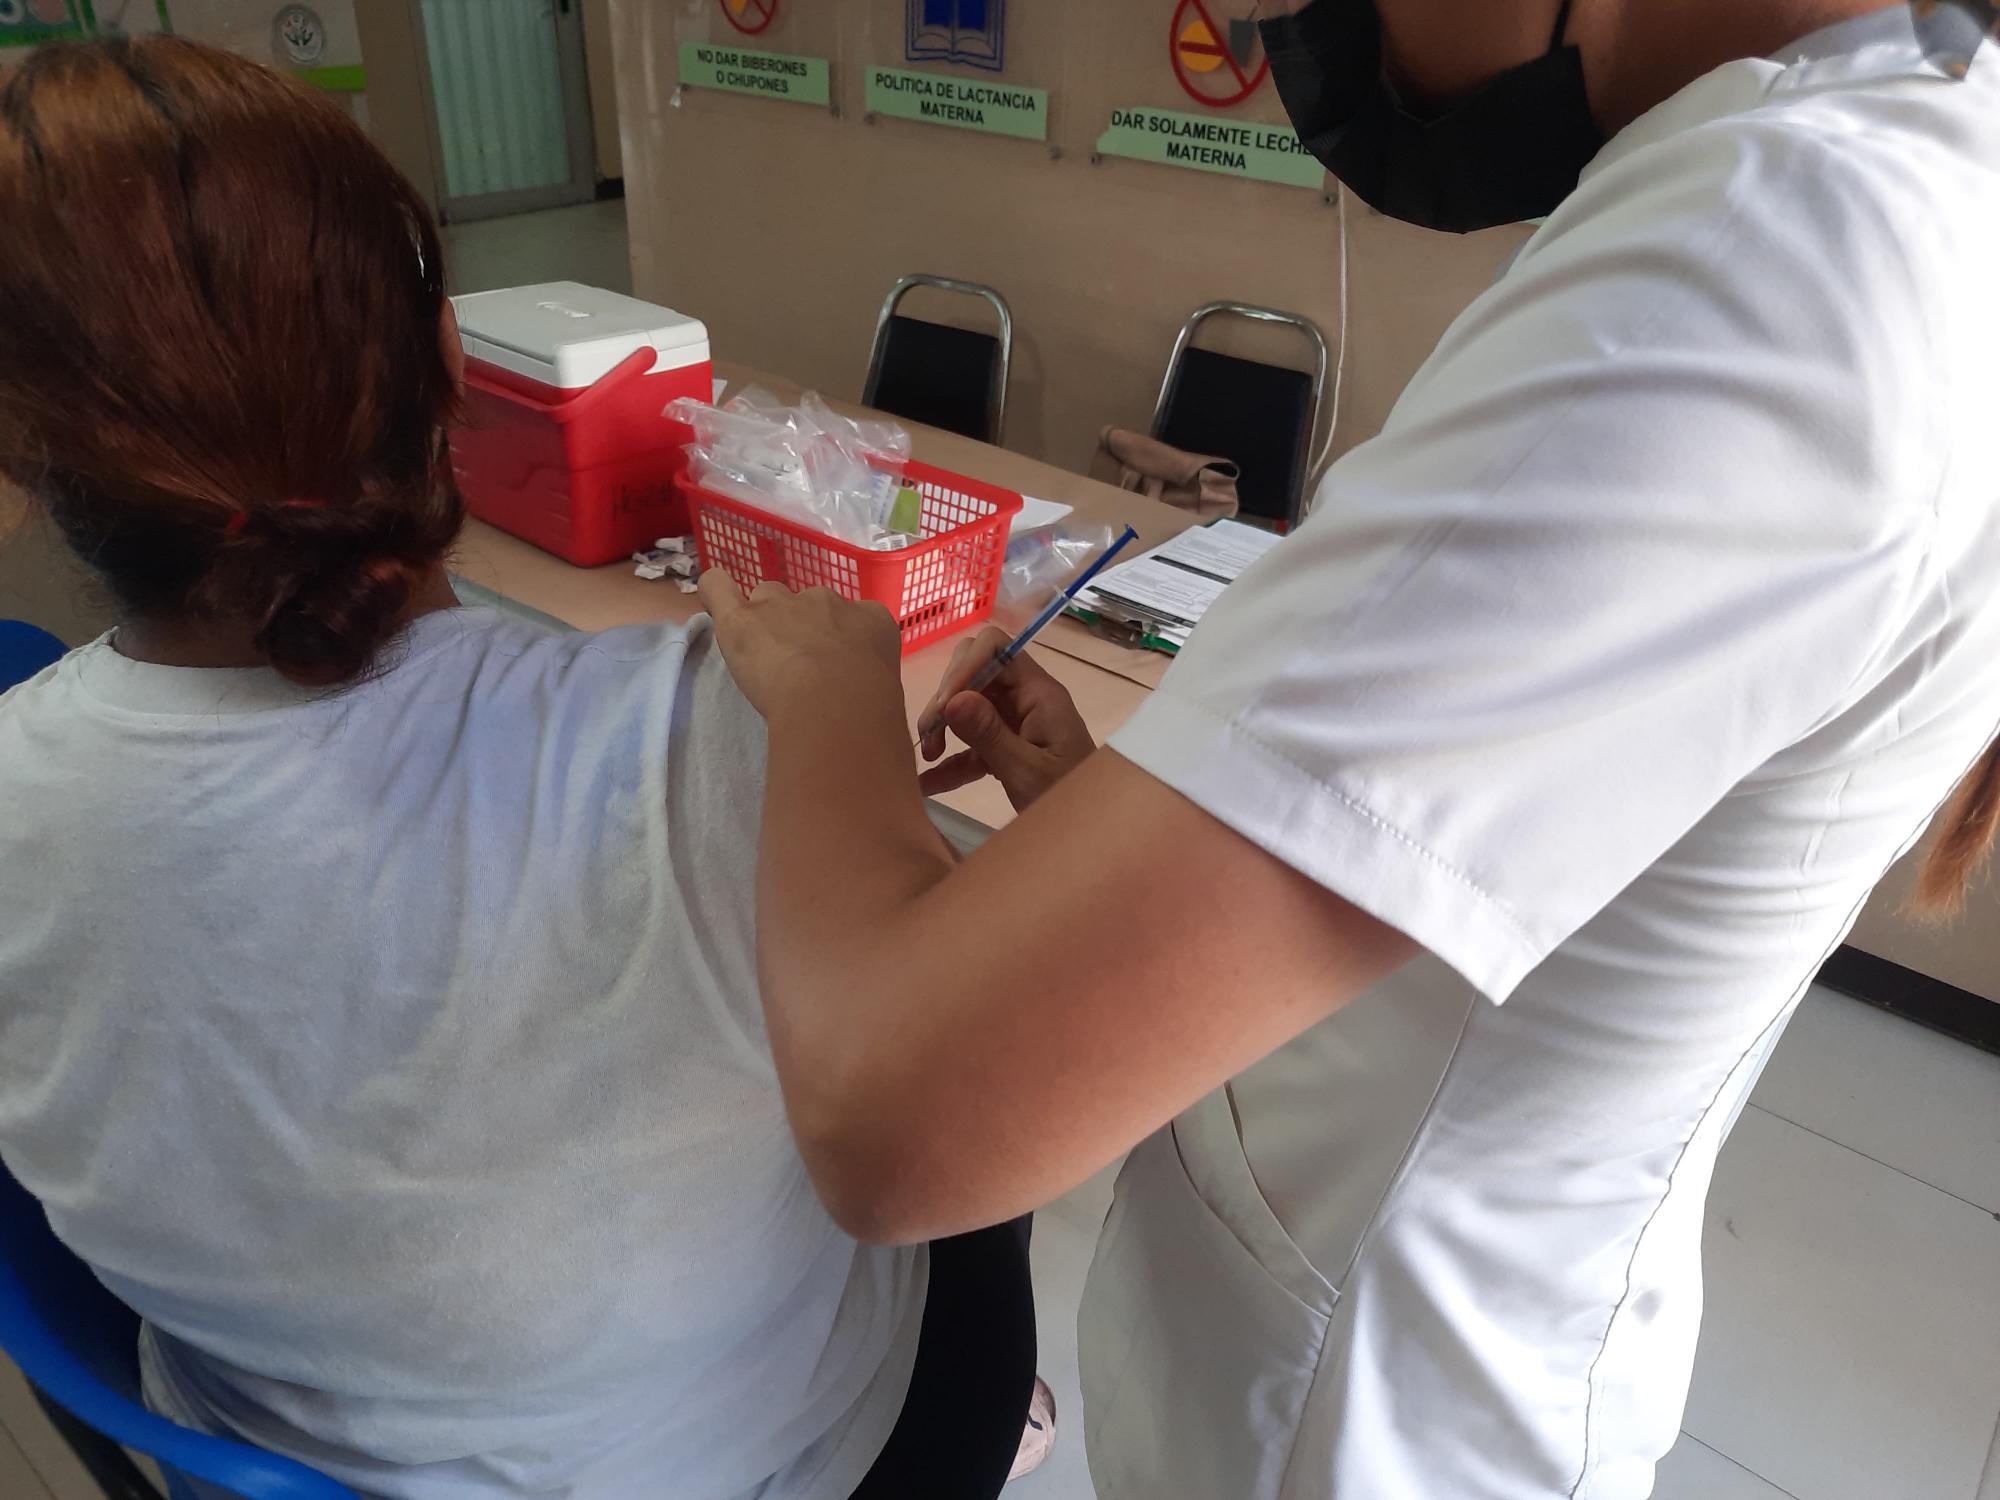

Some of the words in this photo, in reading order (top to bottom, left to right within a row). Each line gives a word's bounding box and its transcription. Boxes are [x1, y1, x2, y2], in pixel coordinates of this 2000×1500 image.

[697, 49, 713, 63] NO
[716, 51, 738, 66] DAR
[742, 55, 808, 76] BIBERONES
[716, 70, 725, 84] O
[727, 72, 788, 93] CHUPONES
[875, 73, 932, 96] POLITICA
[936, 82, 954, 99] DE
[958, 86, 1036, 111] LACTANCIA
[920, 100, 984, 124] MATERNA
[1111, 110, 1144, 130] DAR
[1149, 116, 1251, 147] SOLAMENTE
[1166, 141, 1247, 170] MATERNA
